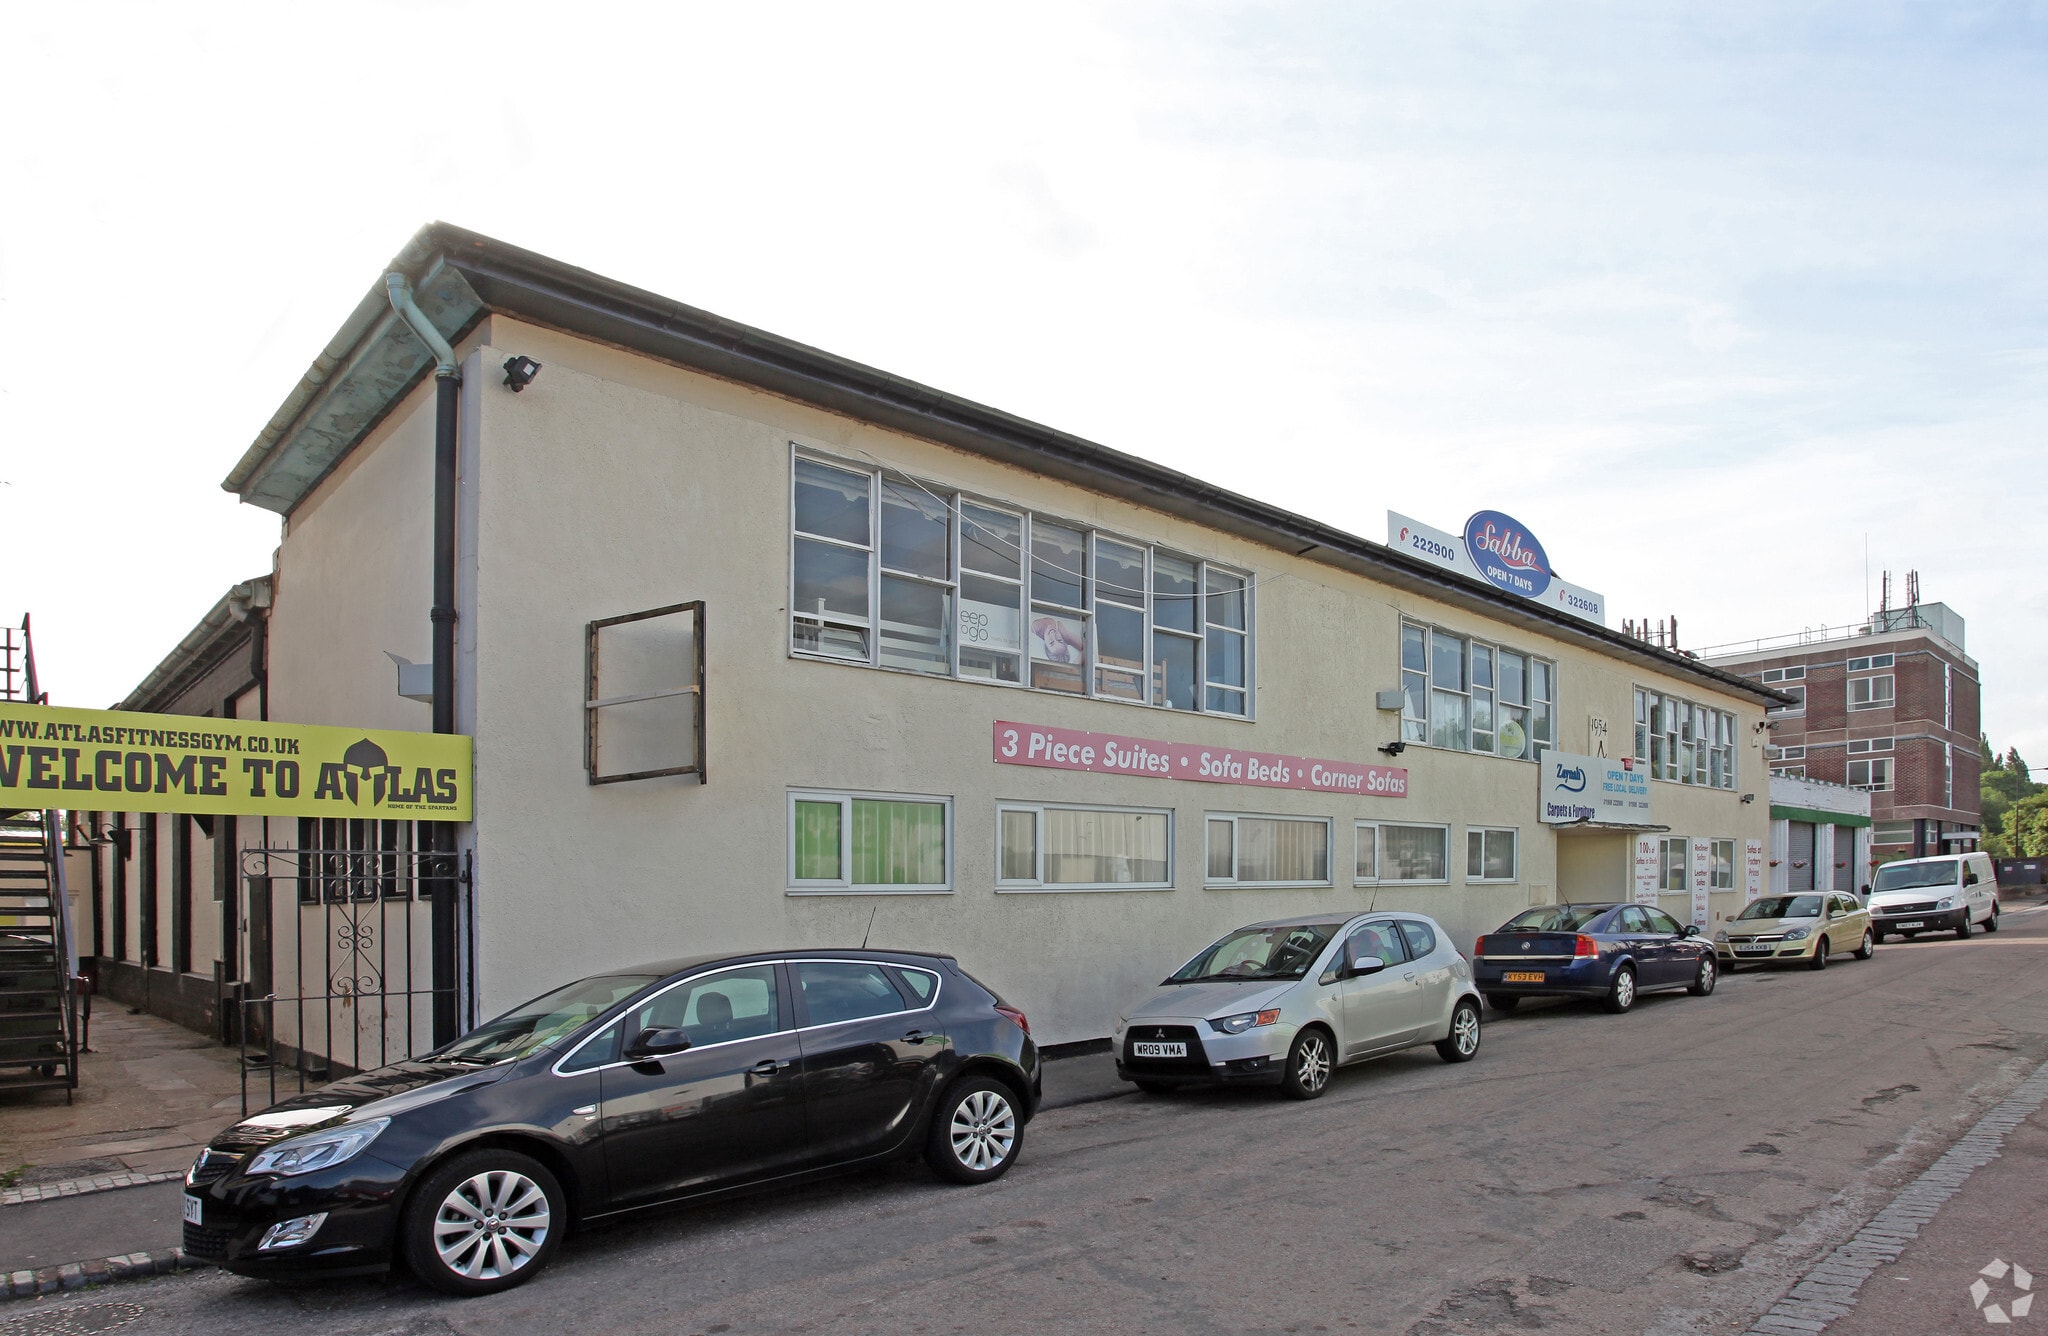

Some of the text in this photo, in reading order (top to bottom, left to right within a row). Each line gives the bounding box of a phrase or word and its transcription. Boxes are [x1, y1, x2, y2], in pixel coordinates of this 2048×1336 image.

[1412, 534, 1455, 561] 222900
[1475, 521, 1537, 567] Sabba
[1487, 565, 1533, 592] OPEN 7 DAYS
[1567, 594, 1599, 614] 322608
[1591, 718, 1608, 736] 1954
[1001, 729, 1405, 793] 3 Piece Suites Sofa Beds Corner Sofas
[242, 758, 299, 799] TO
[313, 738, 458, 807] ATLAS
[1607, 770, 1645, 784] OPEN 7 DAYS
[1602, 782, 1648, 795] FREE LOCAL DELIVERY
[1547, 802, 1595, 819] Carpets & Furniture
[1137, 1044, 1183, 1055] WR09 VMA
